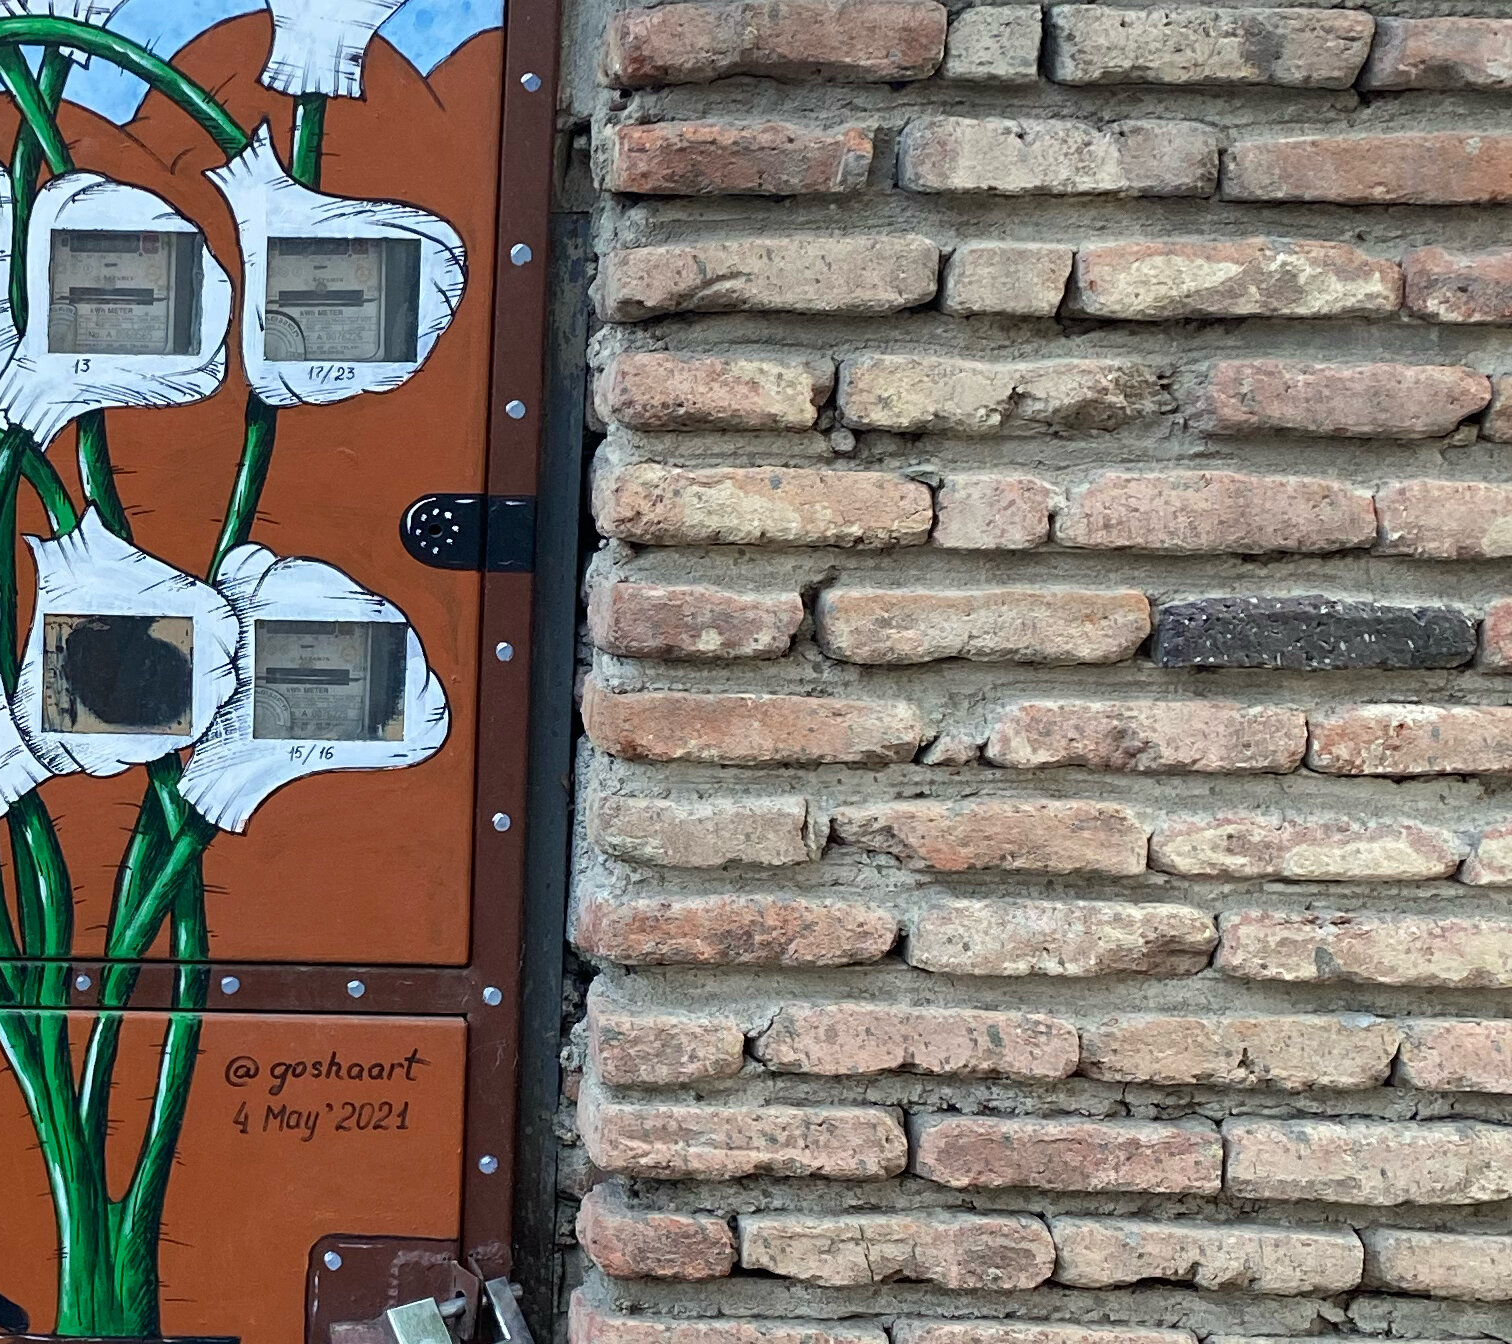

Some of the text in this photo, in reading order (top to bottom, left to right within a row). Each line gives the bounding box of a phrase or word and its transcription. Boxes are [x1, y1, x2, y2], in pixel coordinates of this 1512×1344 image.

[74, 358, 91, 374] 13
[308, 365, 355, 384] 17/23
[289, 744, 334, 765] 15/16
[232, 1100, 249, 1134] 4
